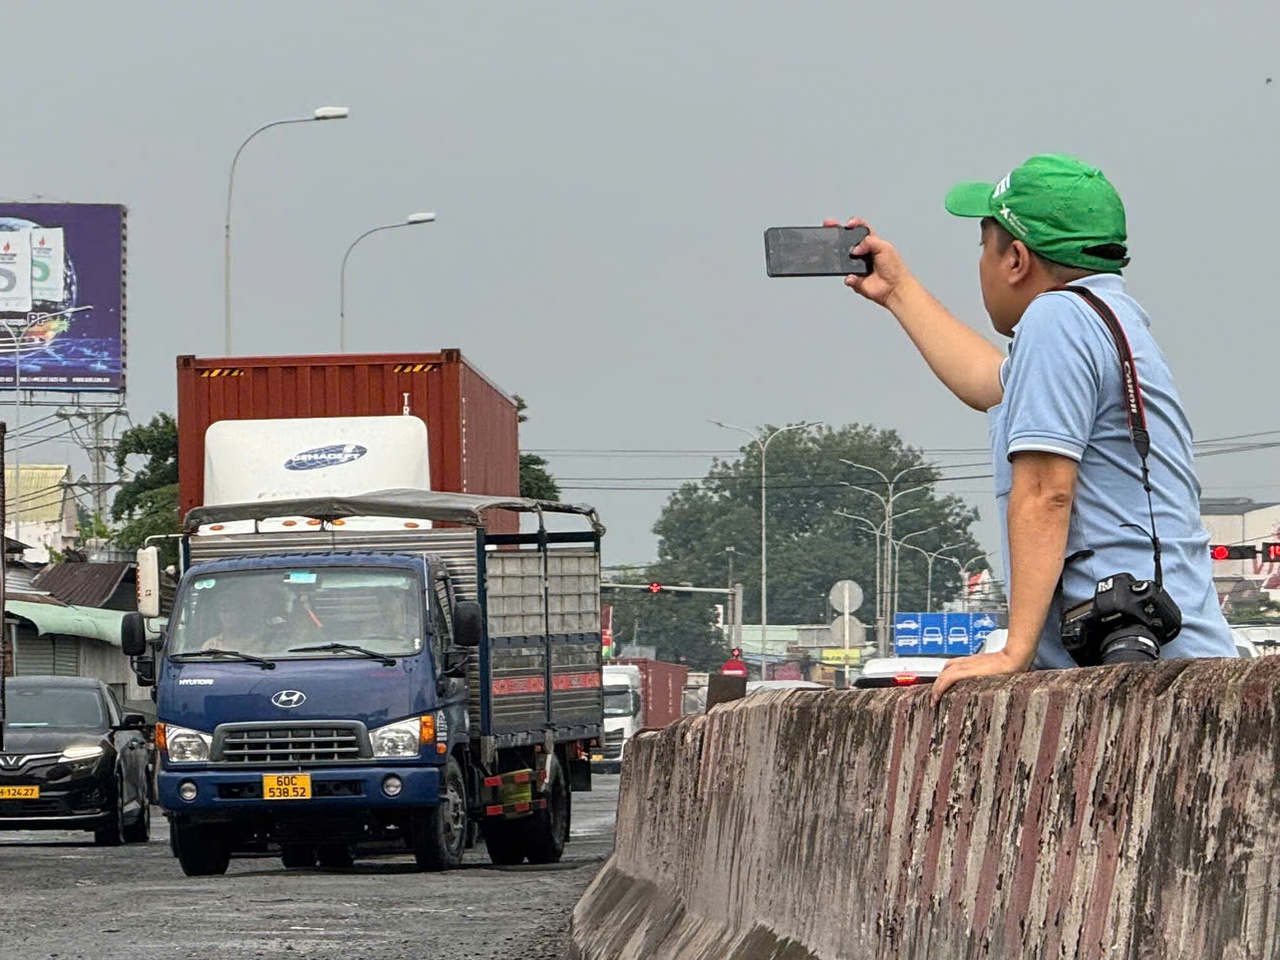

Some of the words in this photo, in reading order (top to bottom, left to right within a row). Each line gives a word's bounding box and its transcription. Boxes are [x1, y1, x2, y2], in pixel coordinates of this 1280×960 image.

[1124, 361, 1138, 413] Canon
[277, 776, 297, 786] 60C
[269, 787, 306, 797] 538.52
